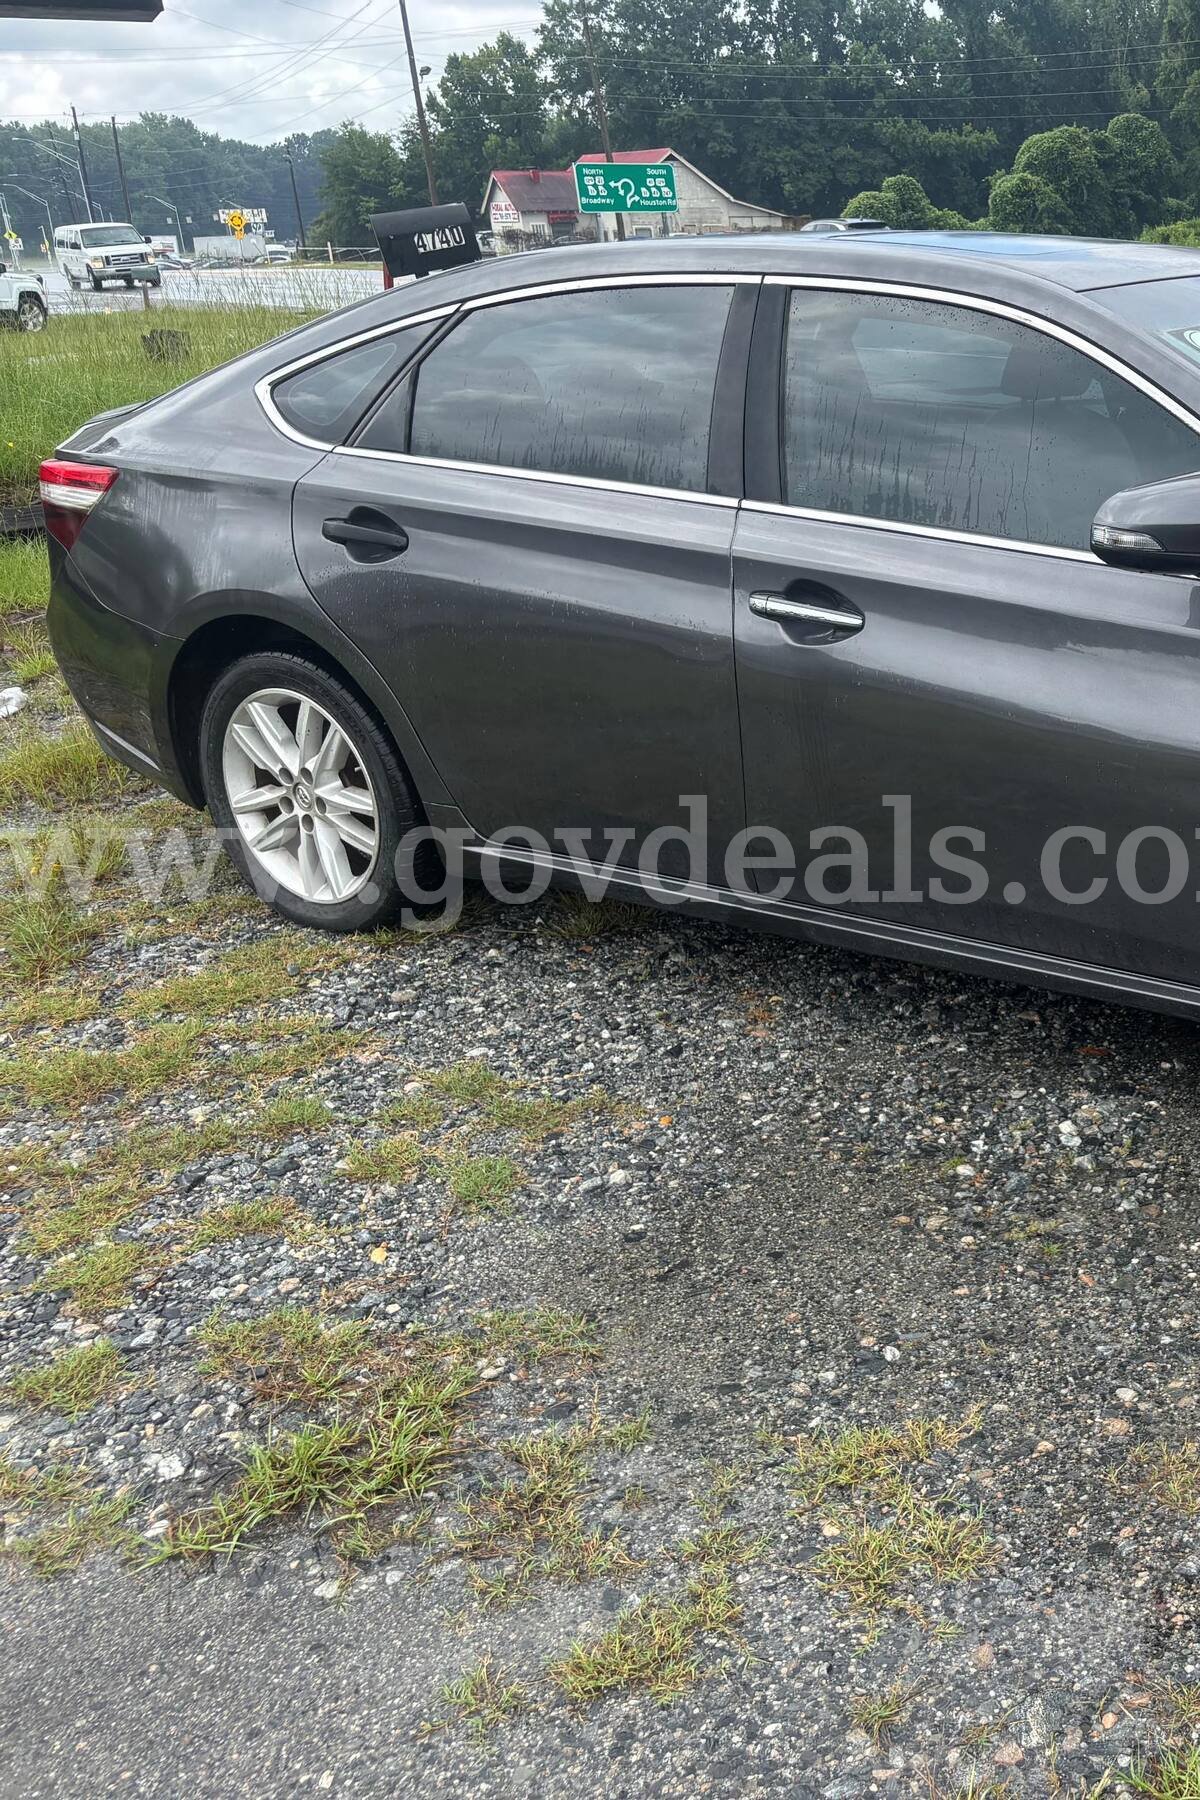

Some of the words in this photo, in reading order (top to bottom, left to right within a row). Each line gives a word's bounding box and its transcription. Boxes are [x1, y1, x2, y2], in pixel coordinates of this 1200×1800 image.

[582, 167, 604, 175] NORTH
[581, 197, 615, 205] Broadway
[414, 226, 465, 252] 4740
